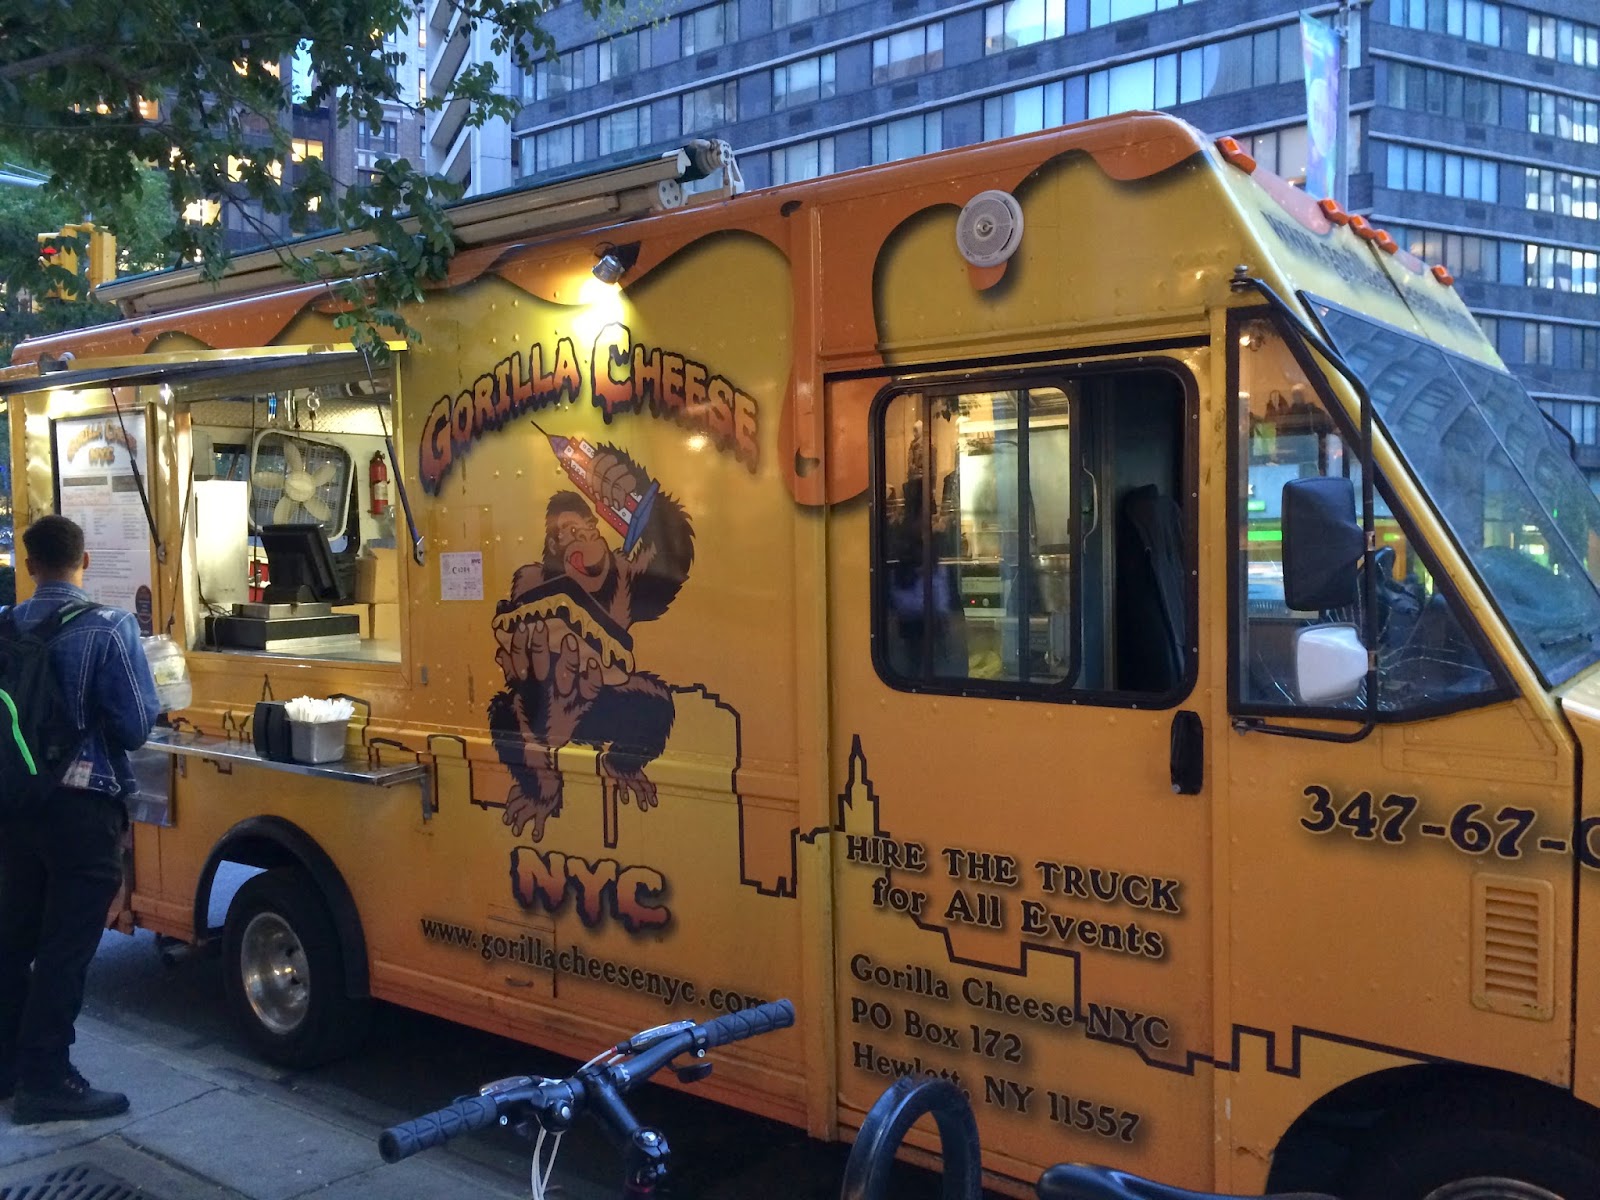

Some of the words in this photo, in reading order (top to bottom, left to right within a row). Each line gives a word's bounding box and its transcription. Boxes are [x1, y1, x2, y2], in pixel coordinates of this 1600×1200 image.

[419, 337, 582, 497] GORILLA
[590, 322, 760, 474] CHEESE
[510, 846, 672, 934] NYC
[846, 834, 926, 871] HIRE
[942, 848, 1018, 885] THE
[1035, 861, 1180, 912] TRUCK
[872, 878, 925, 913] for
[945, 890, 1002, 927] All
[1021, 900, 1165, 958] Events
[850, 954, 949, 999] Gorilla
[962, 978, 1073, 1026] Cheese
[1087, 1003, 1170, 1048] NYC
[852, 998, 892, 1029] PO
[904, 1009, 960, 1048] Box
[970, 1025, 1022, 1063] 172
[984, 1076, 1034, 1113] NY
[1047, 1092, 1140, 1142] 11557
